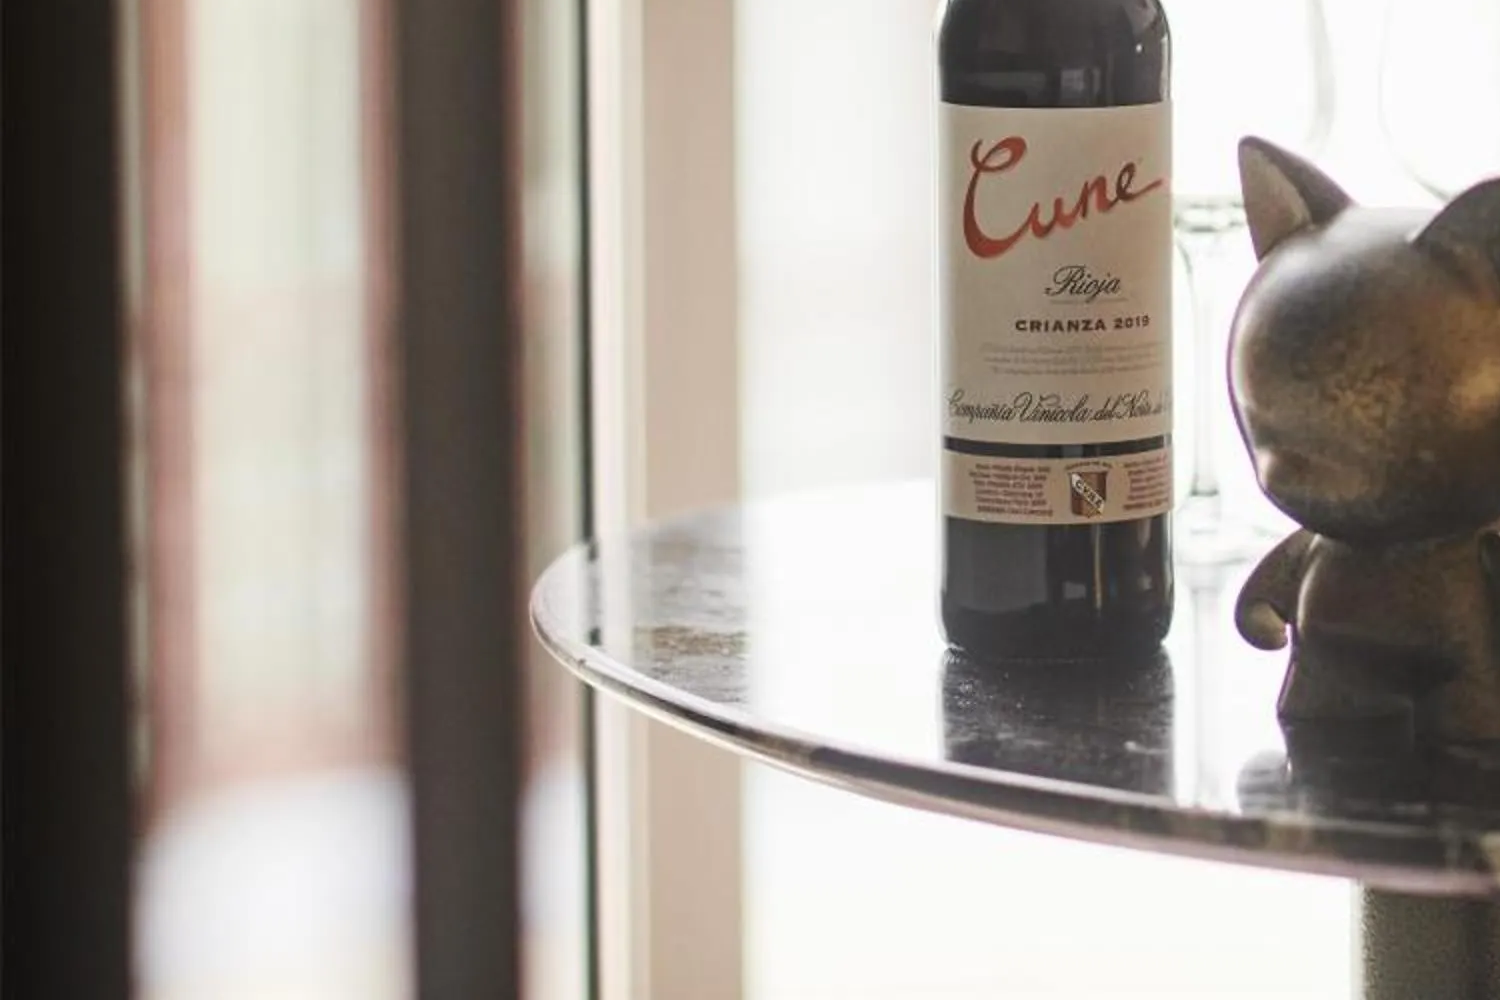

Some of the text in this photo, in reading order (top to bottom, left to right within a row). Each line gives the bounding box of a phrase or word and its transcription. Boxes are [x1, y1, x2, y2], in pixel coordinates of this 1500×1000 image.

[963, 135, 1163, 260] Cune
[1045, 264, 1121, 303] Rioja
[1014, 314, 1150, 333] CRIANZA 2019
